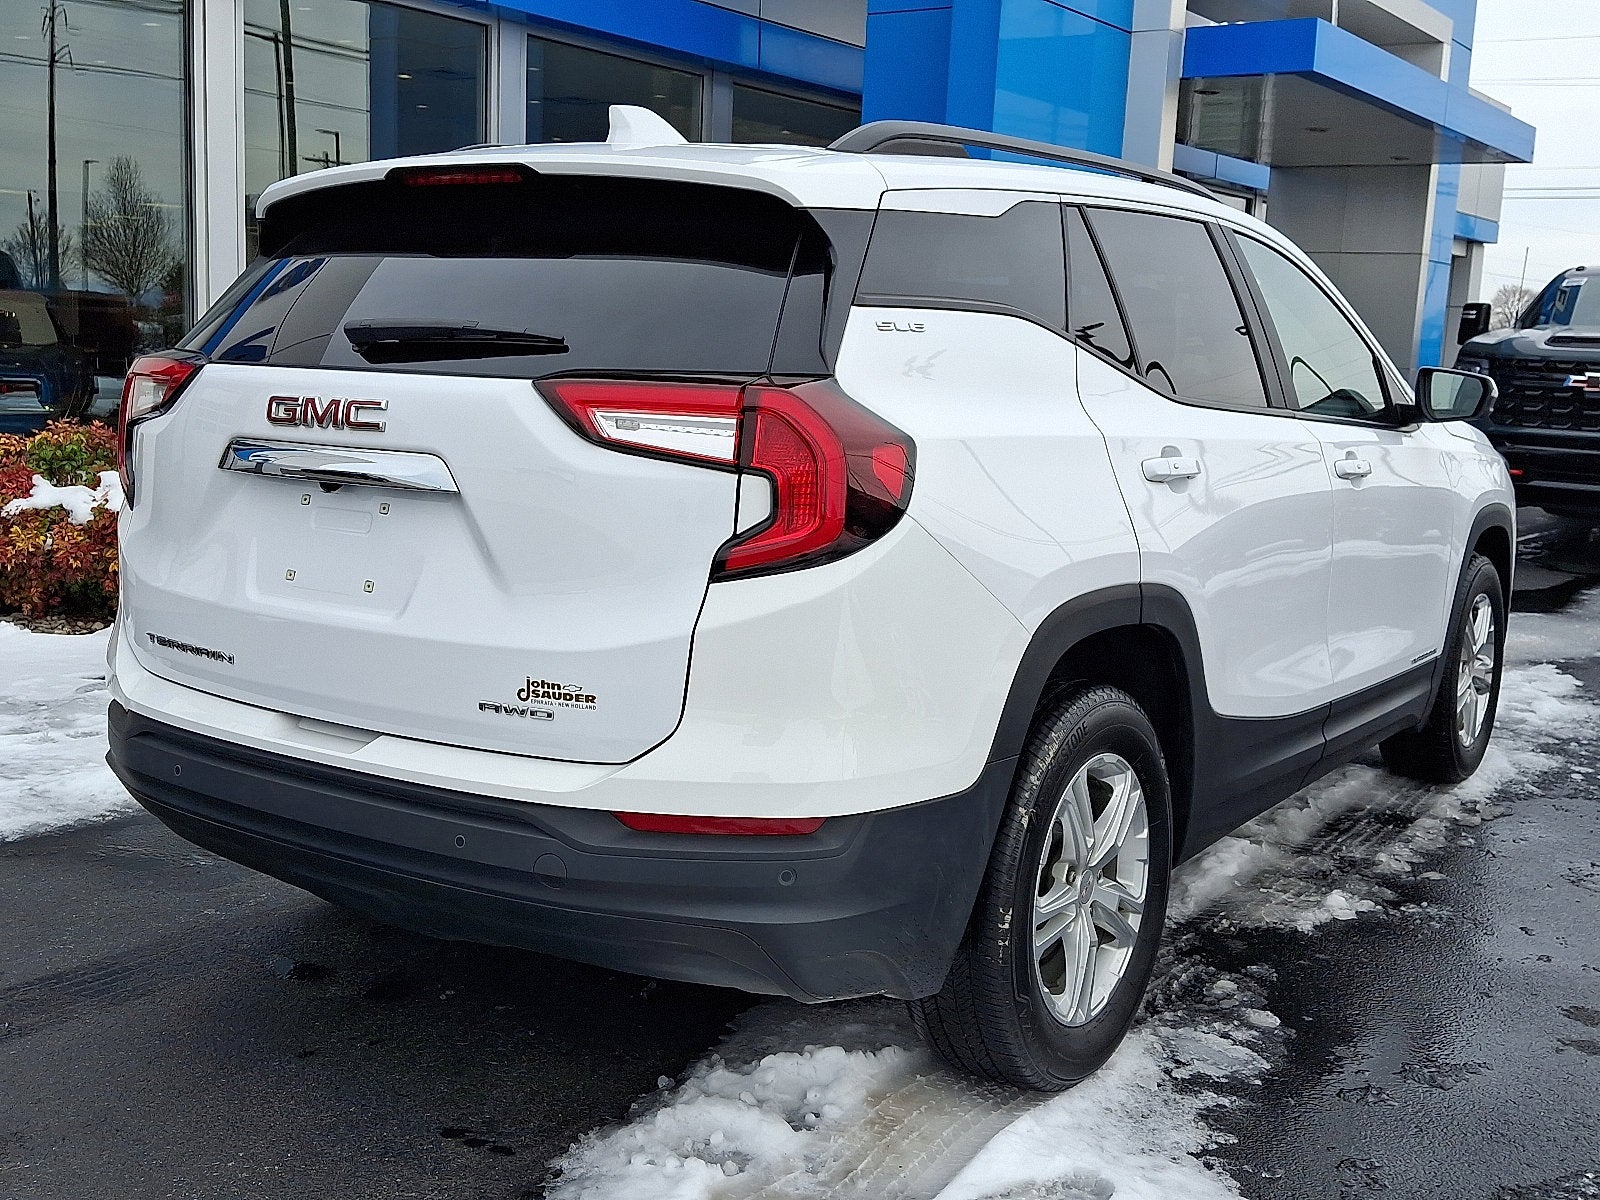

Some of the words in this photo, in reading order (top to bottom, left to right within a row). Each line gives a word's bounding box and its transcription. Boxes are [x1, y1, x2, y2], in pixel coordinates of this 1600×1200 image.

[266, 395, 389, 432] GMC
[146, 632, 235, 665] TERRAIN
[530, 698, 554, 707] EPHRATA
[570, 703, 597, 711] HOLLAND
[531, 689, 597, 704] SAUDER
[478, 701, 555, 721] AWD
